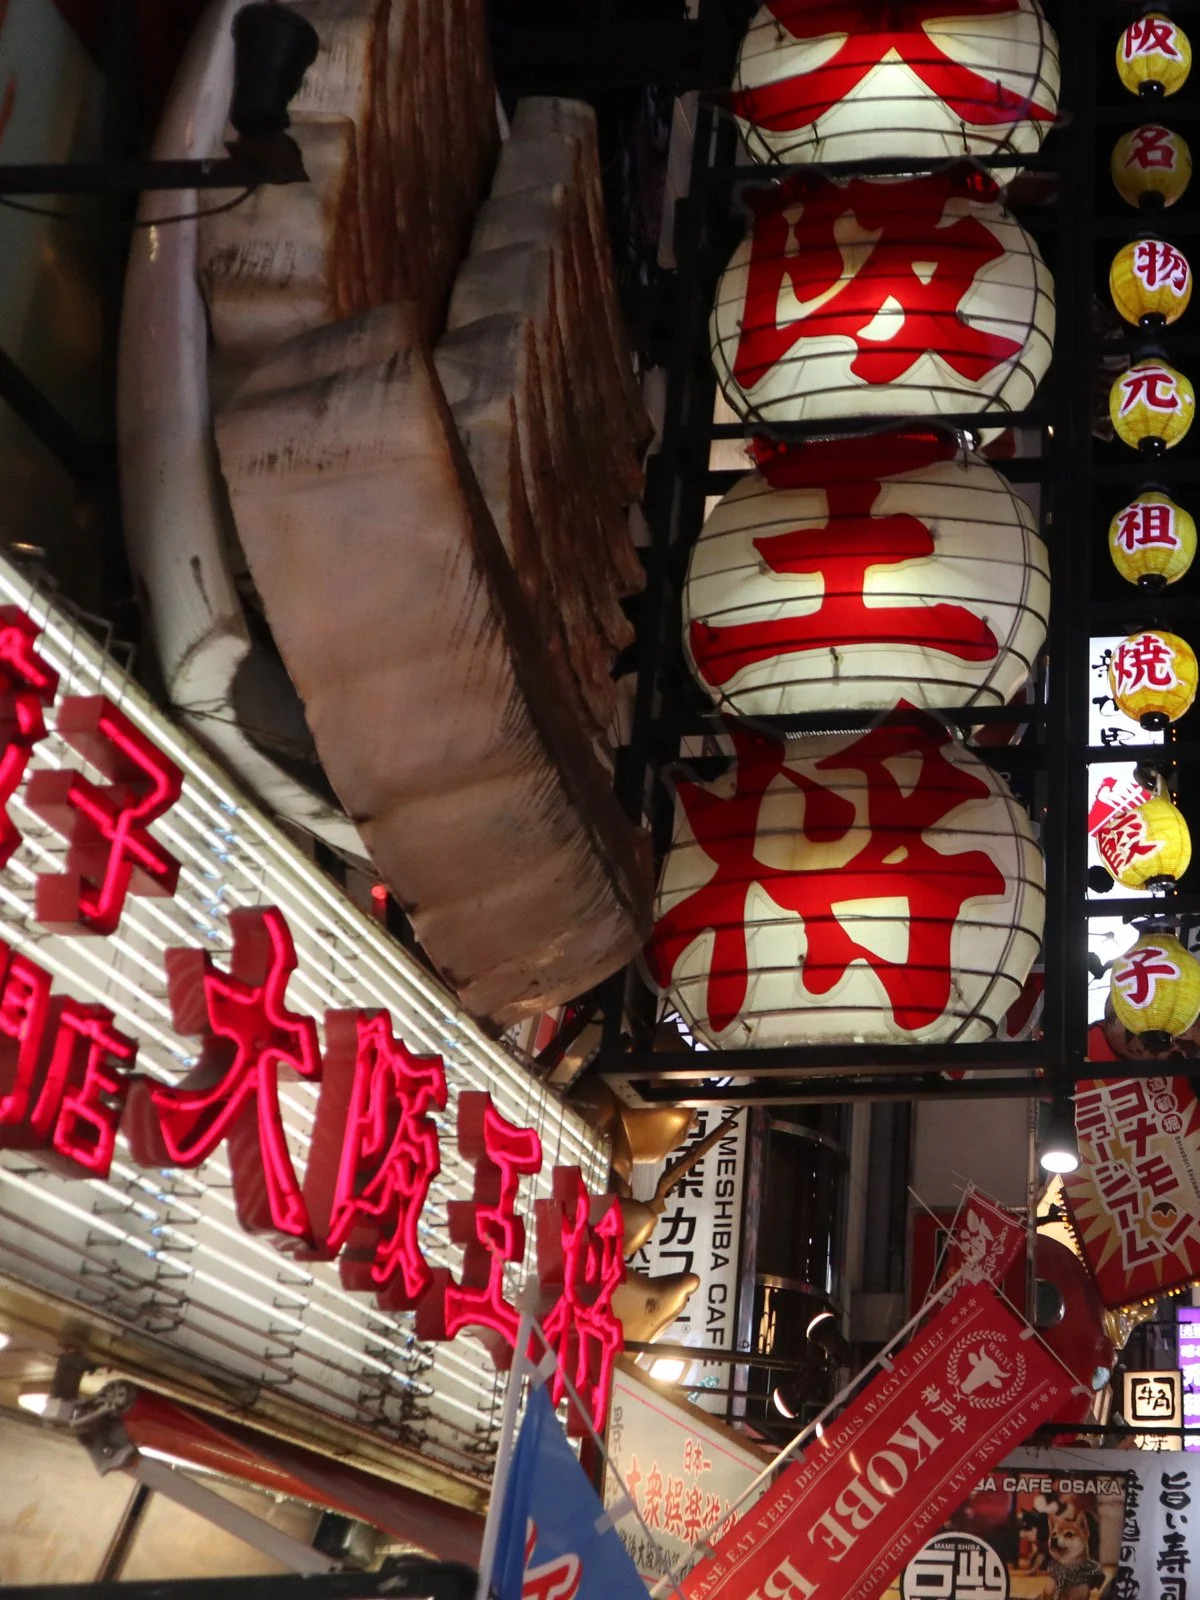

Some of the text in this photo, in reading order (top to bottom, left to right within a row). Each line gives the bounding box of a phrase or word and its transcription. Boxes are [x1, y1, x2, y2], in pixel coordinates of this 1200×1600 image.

[987, 1341, 1013, 1370] WAGYU
[920, 1383, 967, 1434] 神戸牛
[1137, 1386, 1170, 1411] 牛角
[726, 1530, 757, 1563] EAT
[758, 1493, 796, 1531] VERY
[795, 1416, 864, 1489] DELICIOUS
[864, 1364, 910, 1411] WAGYU
[913, 1328, 945, 1364] BEEF
[976, 1412, 1028, 1462] PLEASE
[807, 1410, 944, 1563] KOBE
[950, 1462, 977, 1493] EAT
[1003, 1478, 1053, 1493] CAFE
[1058, 1479, 1122, 1496] OSAKA
[914, 1495, 948, 1534] VERY
[958, 1543, 981, 1551] SHIBA
[745, 1555, 820, 1600] B
